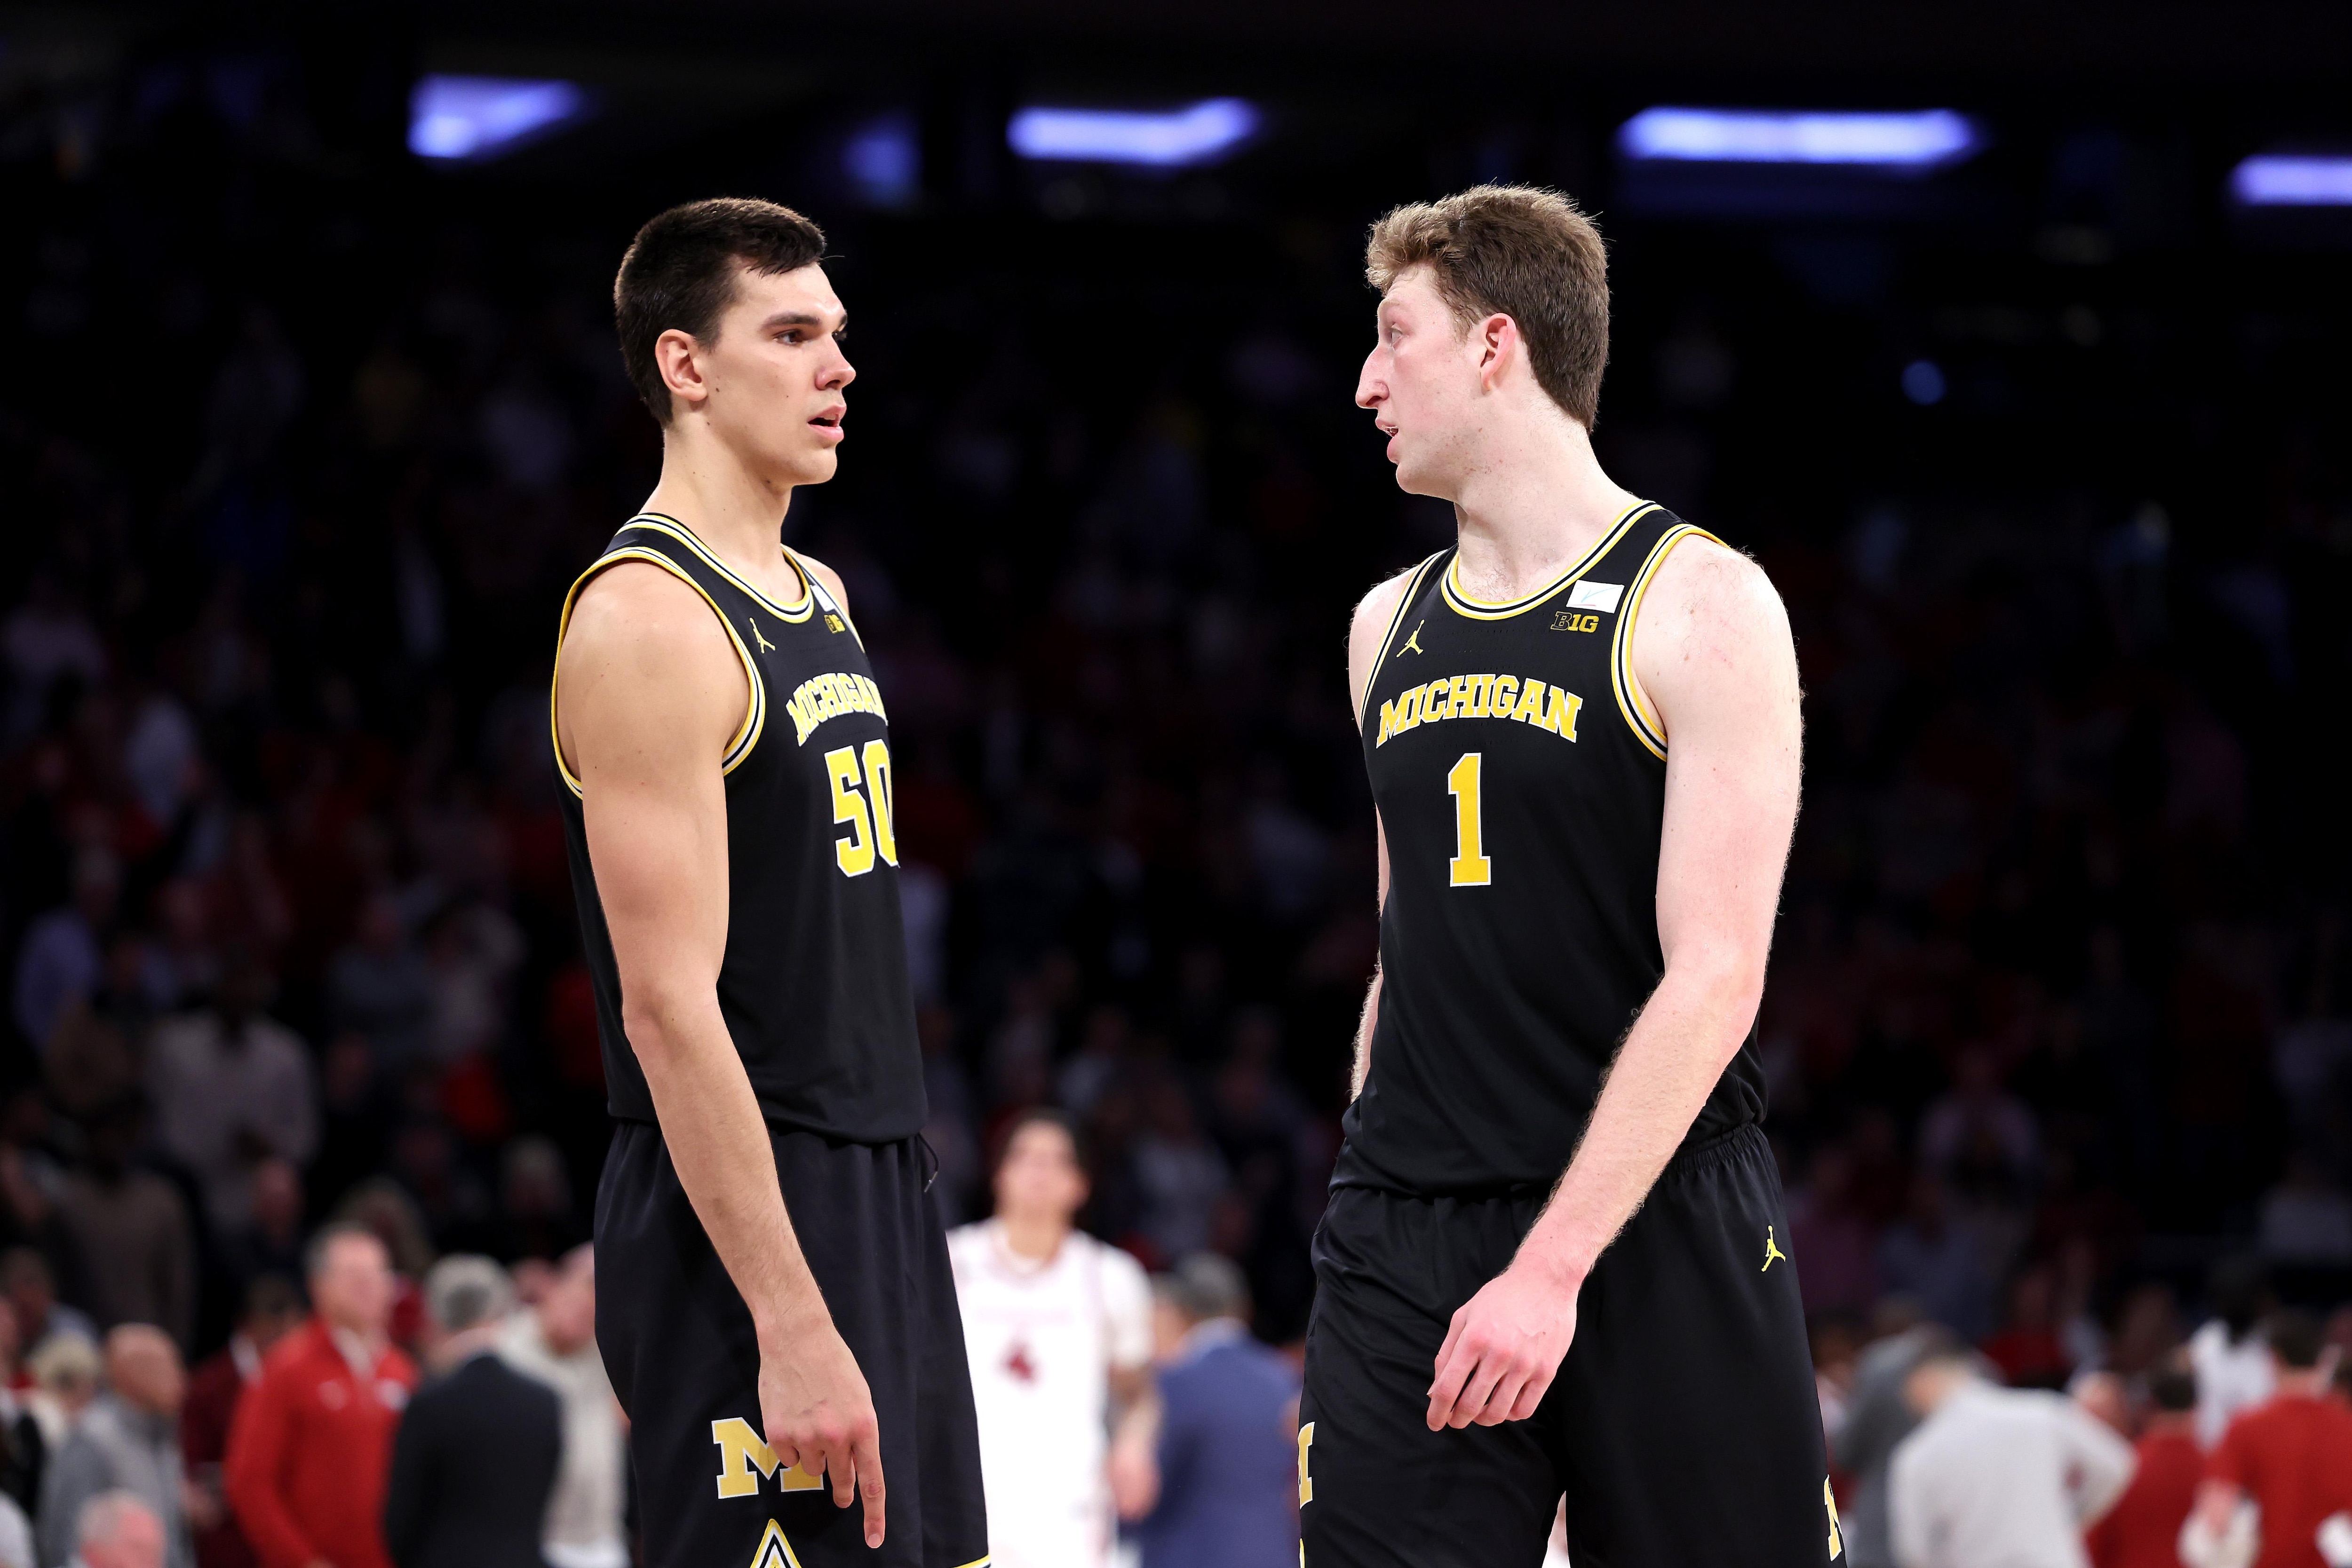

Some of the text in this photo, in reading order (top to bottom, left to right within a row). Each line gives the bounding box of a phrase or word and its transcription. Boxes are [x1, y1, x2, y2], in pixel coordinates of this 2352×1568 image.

[1376, 674, 1583, 749] MICHIGAN
[825, 739, 899, 877] 50
[1448, 752, 1491, 887] 1
